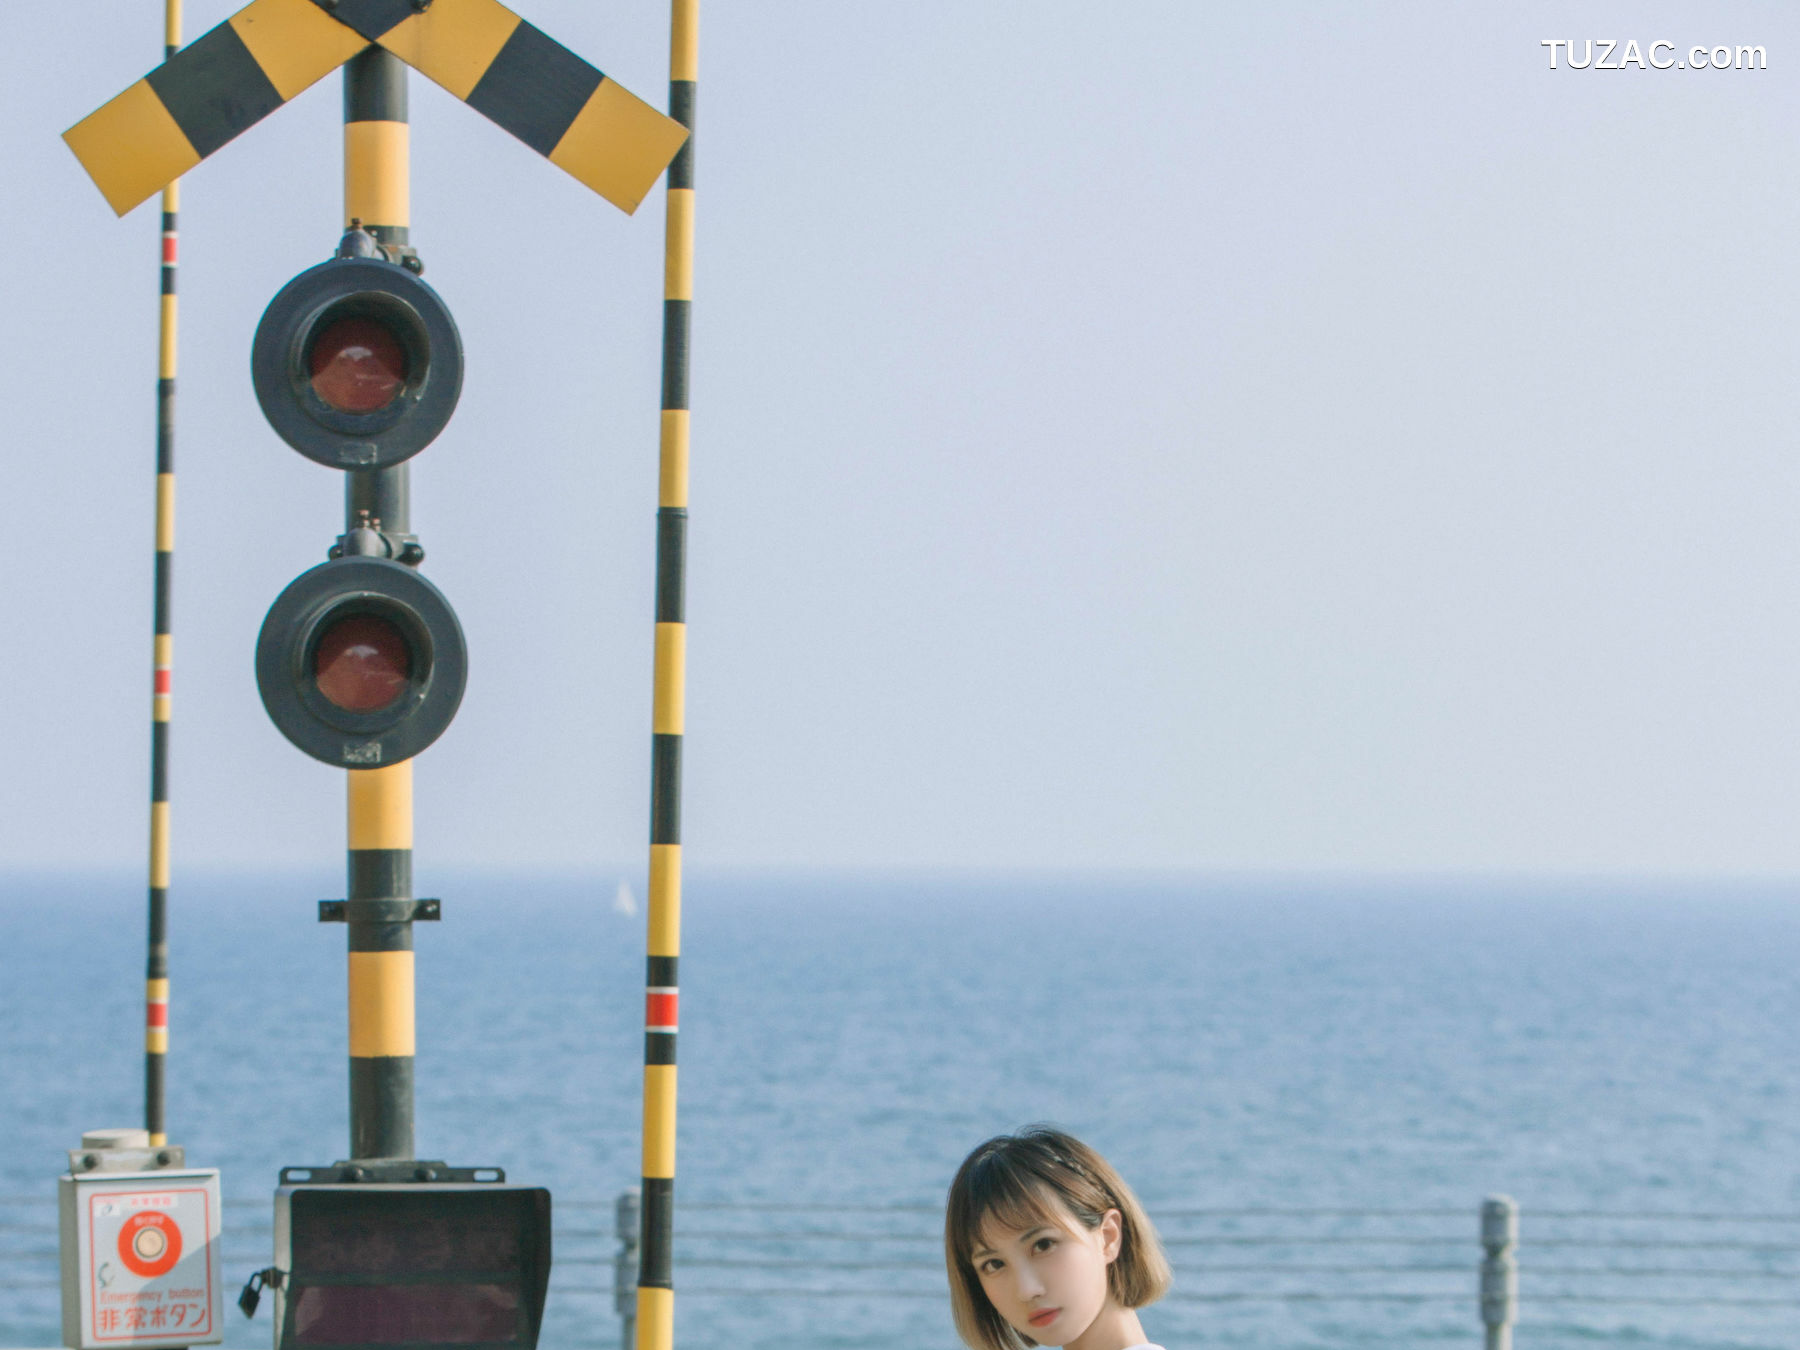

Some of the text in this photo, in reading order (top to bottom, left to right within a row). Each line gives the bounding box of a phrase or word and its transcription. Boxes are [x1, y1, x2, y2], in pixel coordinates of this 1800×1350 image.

[101, 1290, 163, 1304] Emergency
[97, 1303, 206, 1332] 非常ボタン
